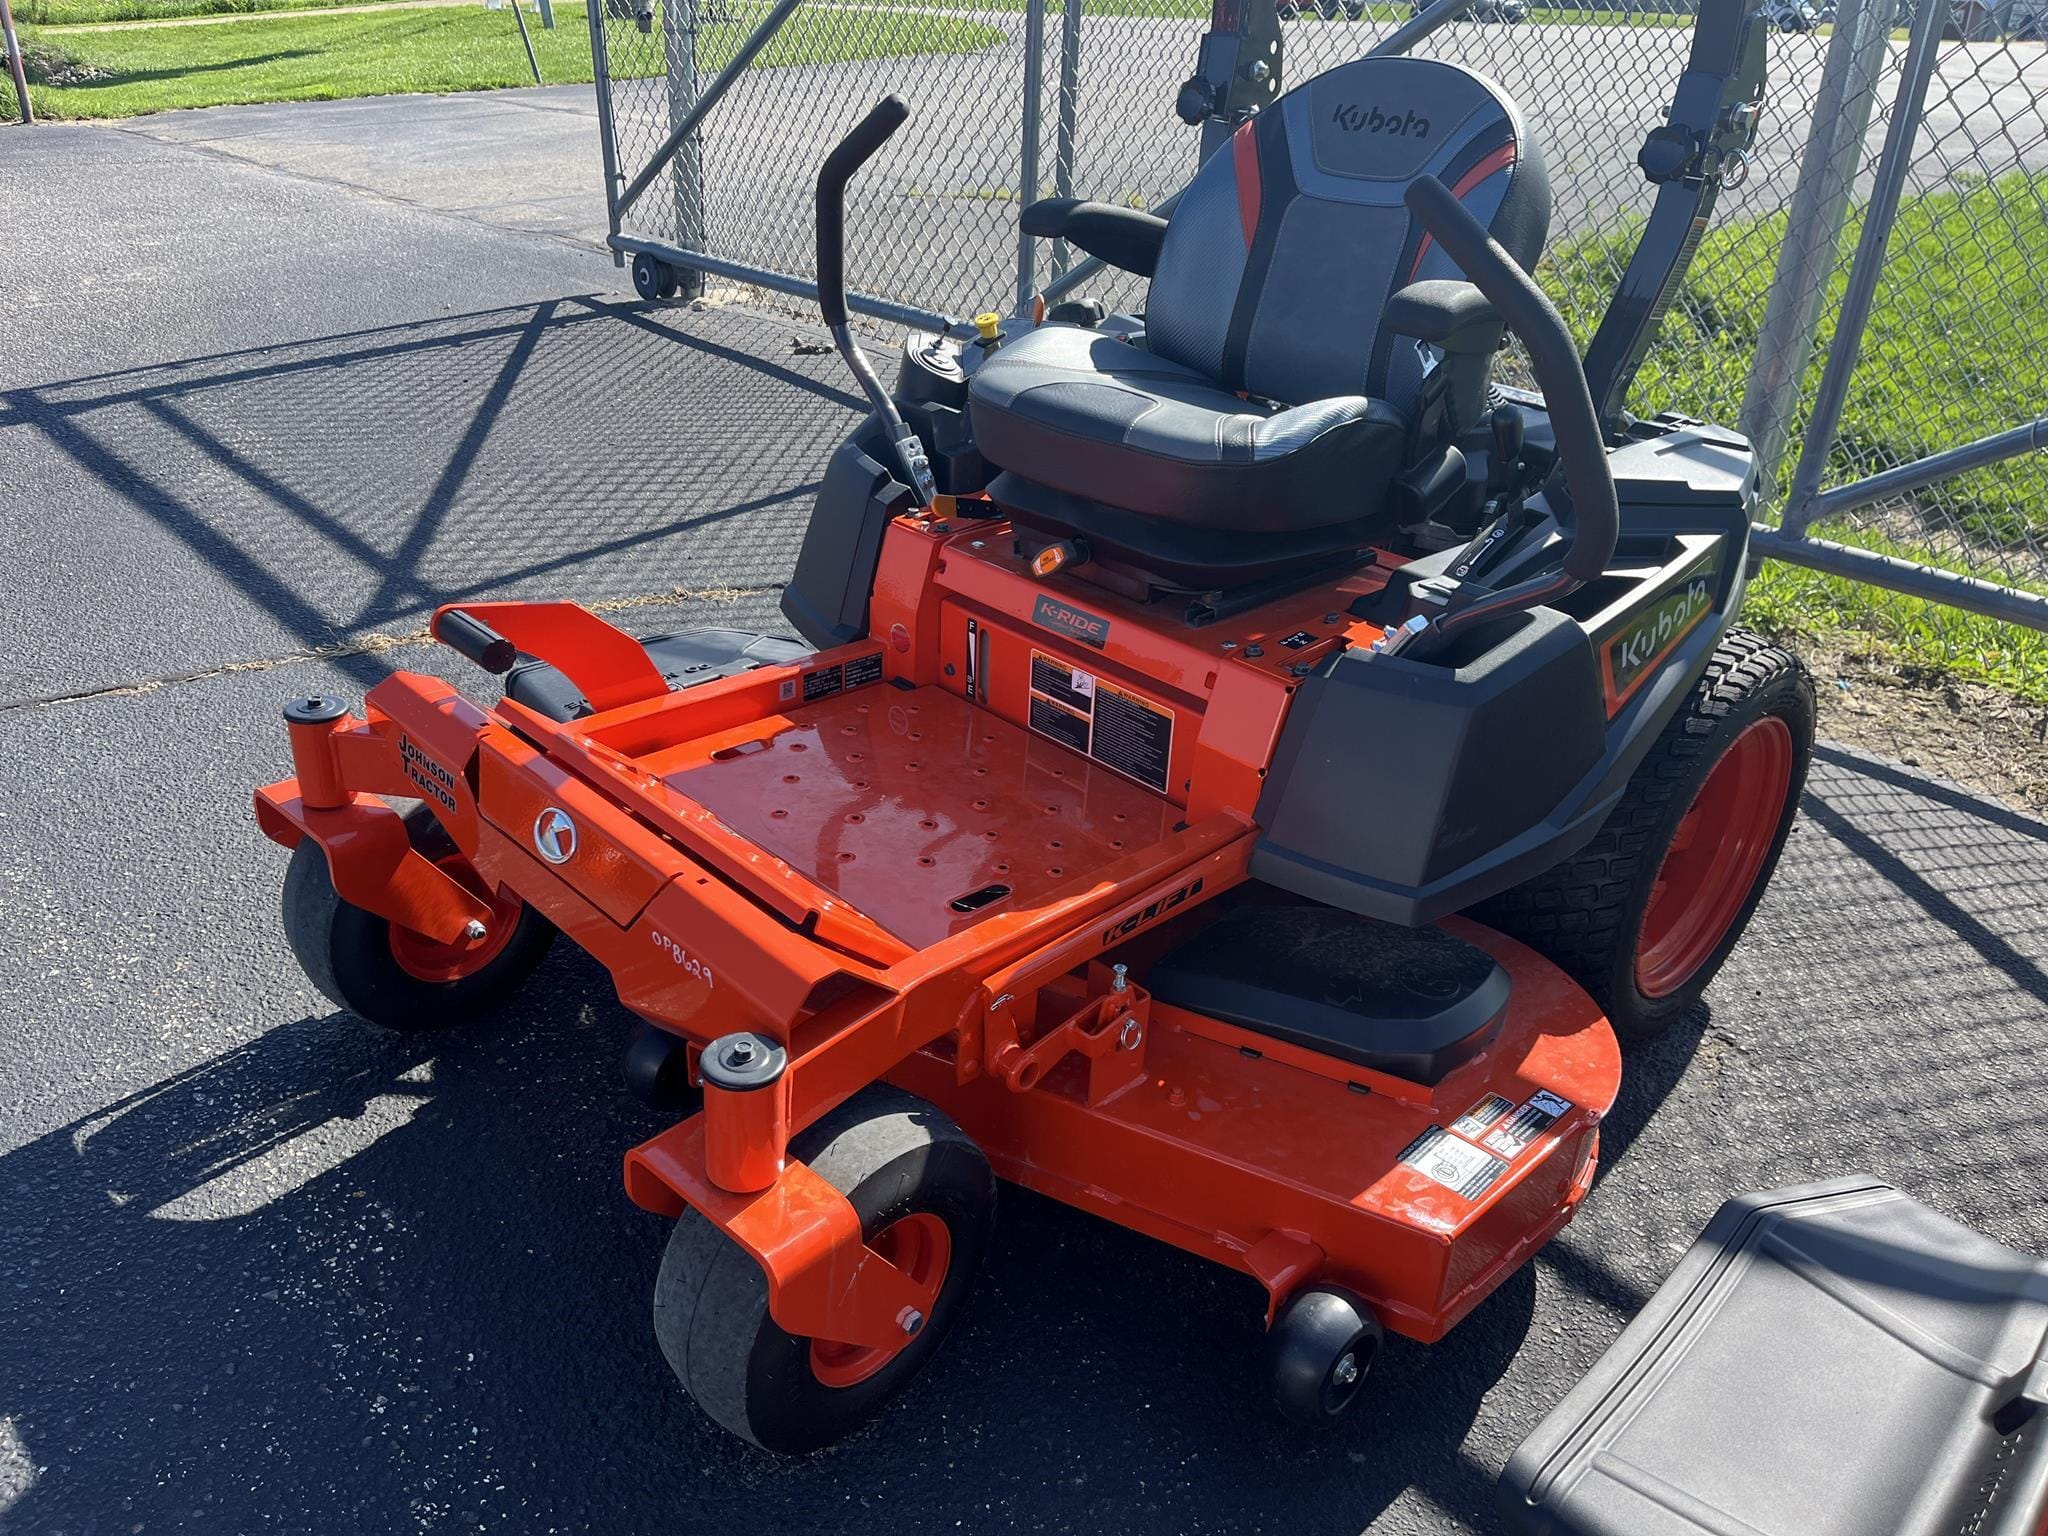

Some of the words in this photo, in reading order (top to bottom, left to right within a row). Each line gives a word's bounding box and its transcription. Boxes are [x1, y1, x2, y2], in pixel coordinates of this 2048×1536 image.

[1331, 103, 1430, 138] Kubota
[1040, 602, 1103, 636] K-RIDE
[1621, 580, 1706, 668] Kubota
[399, 734, 455, 790] JOHNSON
[401, 753, 456, 813] TRACTOR
[1104, 878, 1203, 946] K-LIFT
[1507, 1104, 1532, 1126] DANGER
